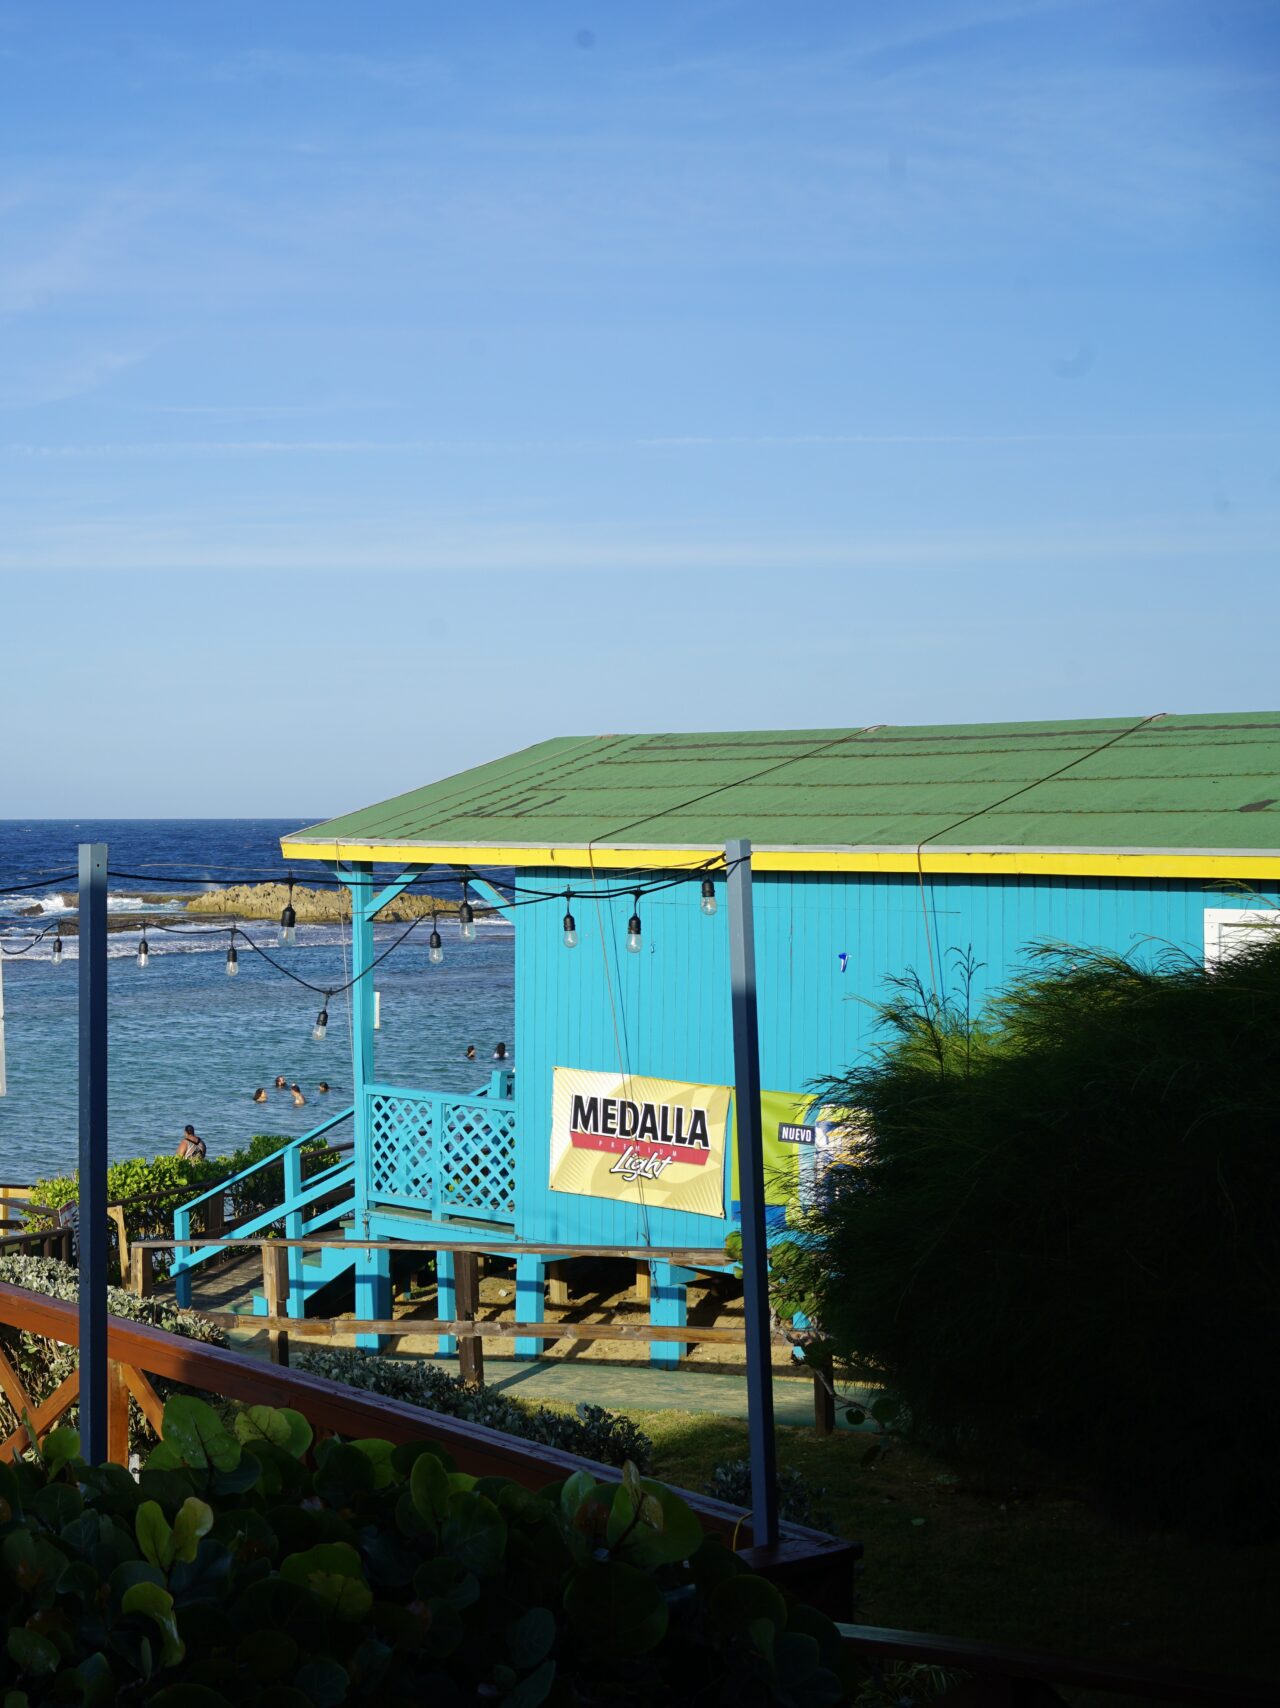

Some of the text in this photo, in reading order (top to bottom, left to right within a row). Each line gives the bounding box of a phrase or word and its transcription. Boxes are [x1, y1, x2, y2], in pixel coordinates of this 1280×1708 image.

[571, 1094, 711, 1149] MEDALLA
[781, 1126, 812, 1142] NUEVO
[598, 1140, 677, 1157] PREMIUM
[609, 1145, 672, 1181] Light
